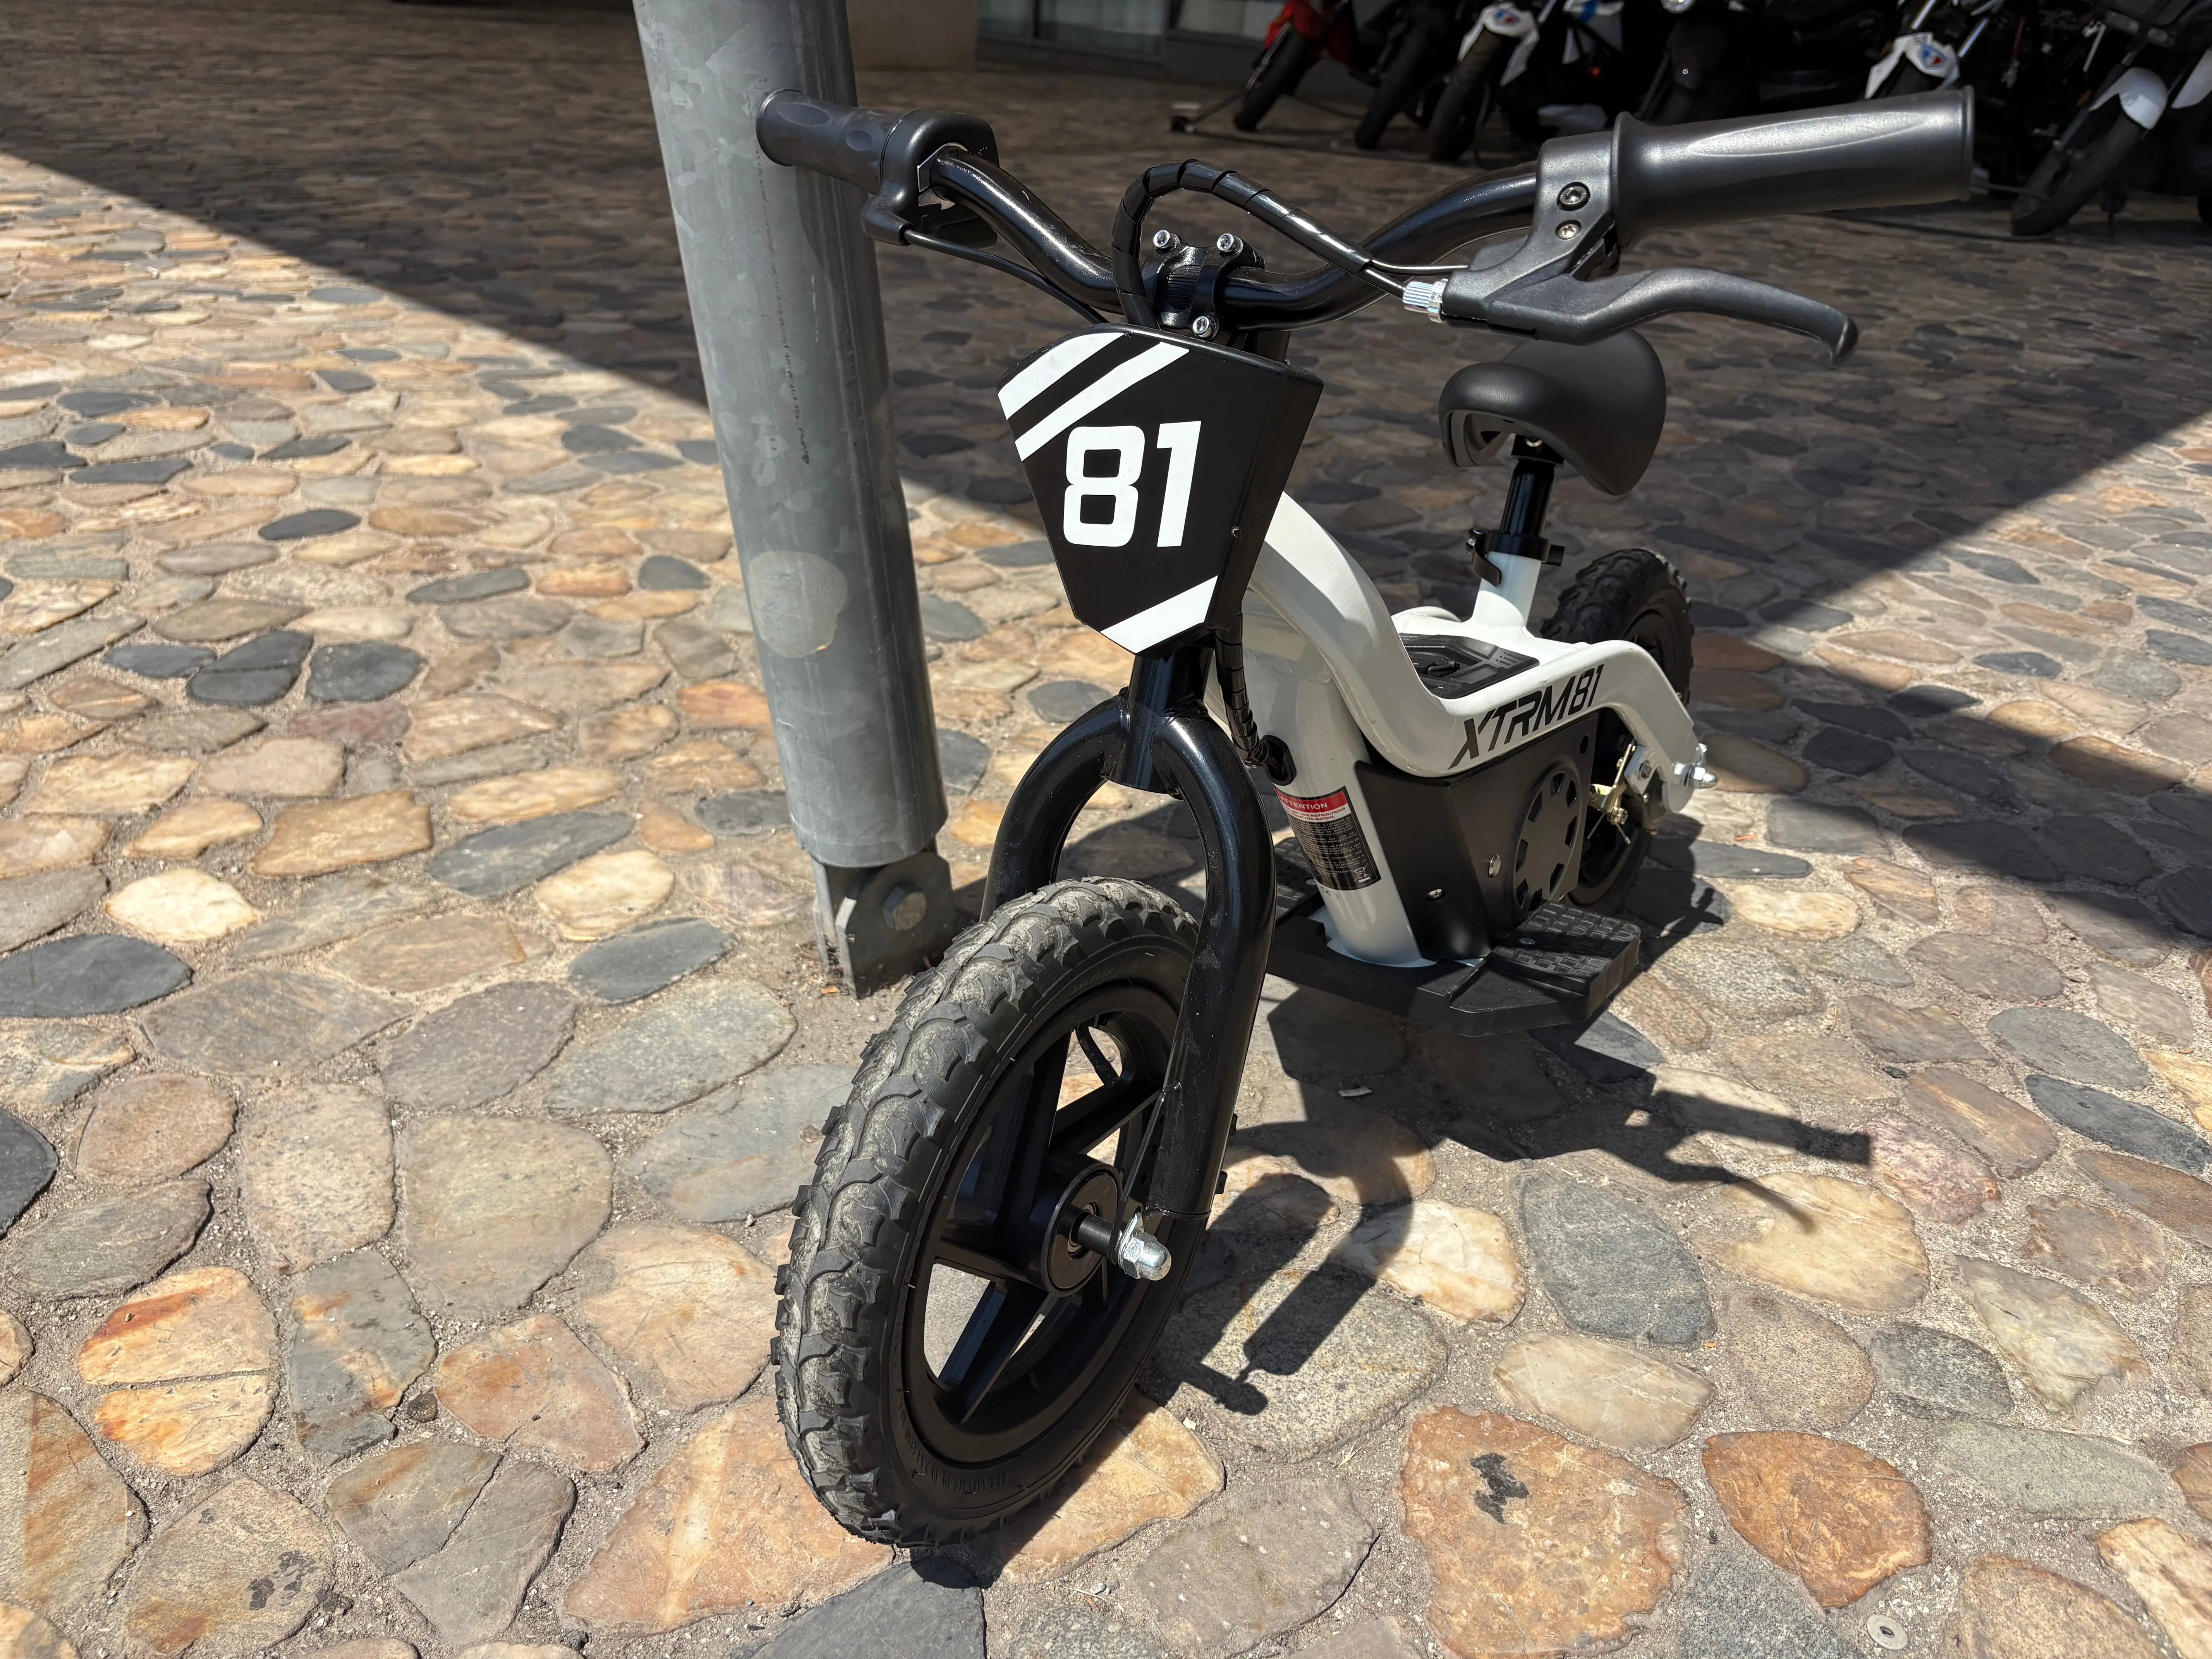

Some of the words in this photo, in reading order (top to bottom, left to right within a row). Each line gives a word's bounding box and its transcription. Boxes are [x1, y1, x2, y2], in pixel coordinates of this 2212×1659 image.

[1063, 421, 1202, 548] 81
[1447, 663, 1605, 770] XTRM81
[1280, 796, 1328, 809] ATTENTION
[1310, 807, 1346, 817] INSTRUCTIONS
